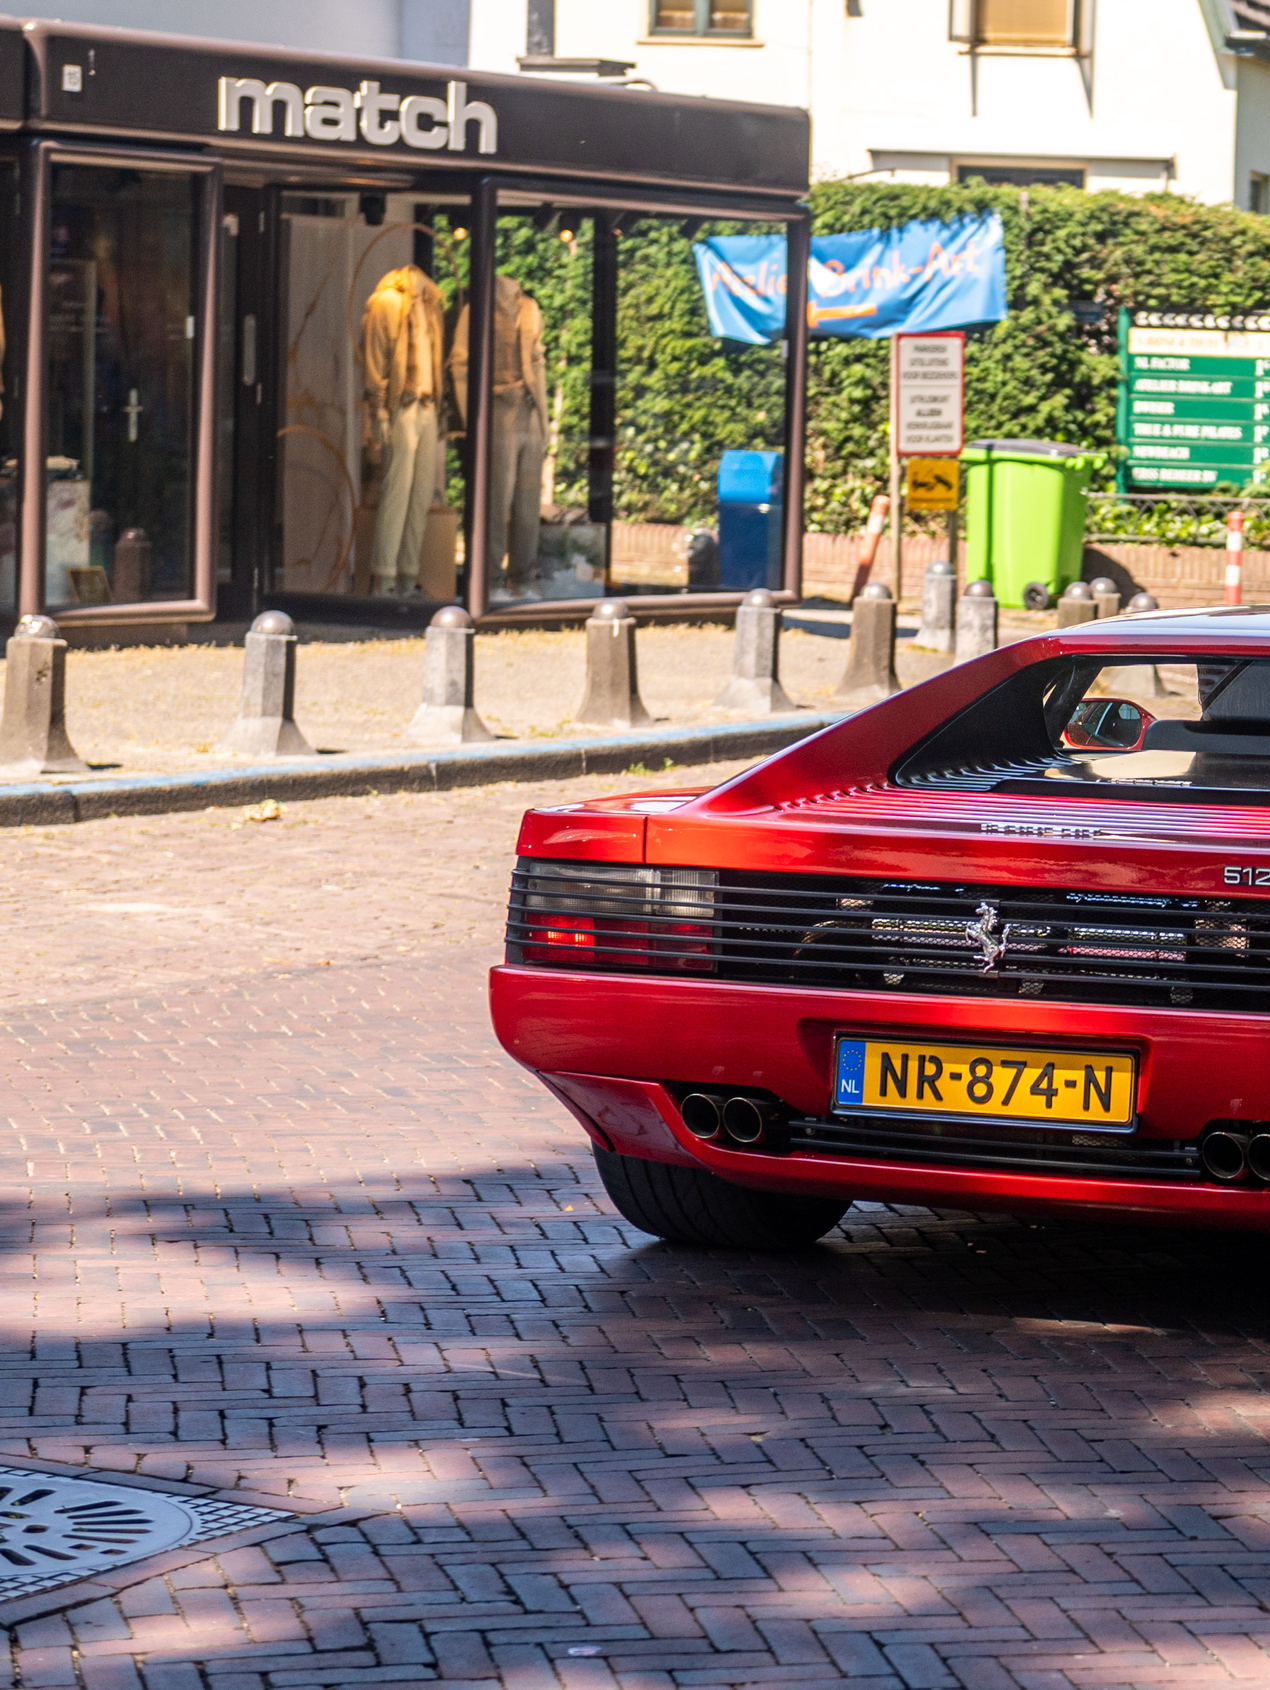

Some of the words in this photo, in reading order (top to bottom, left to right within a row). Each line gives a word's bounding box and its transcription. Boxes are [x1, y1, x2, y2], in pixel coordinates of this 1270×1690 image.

[218, 76, 499, 154] match
[841, 1079, 859, 1094] NL
[879, 1052, 1113, 1112] NR-874-N
